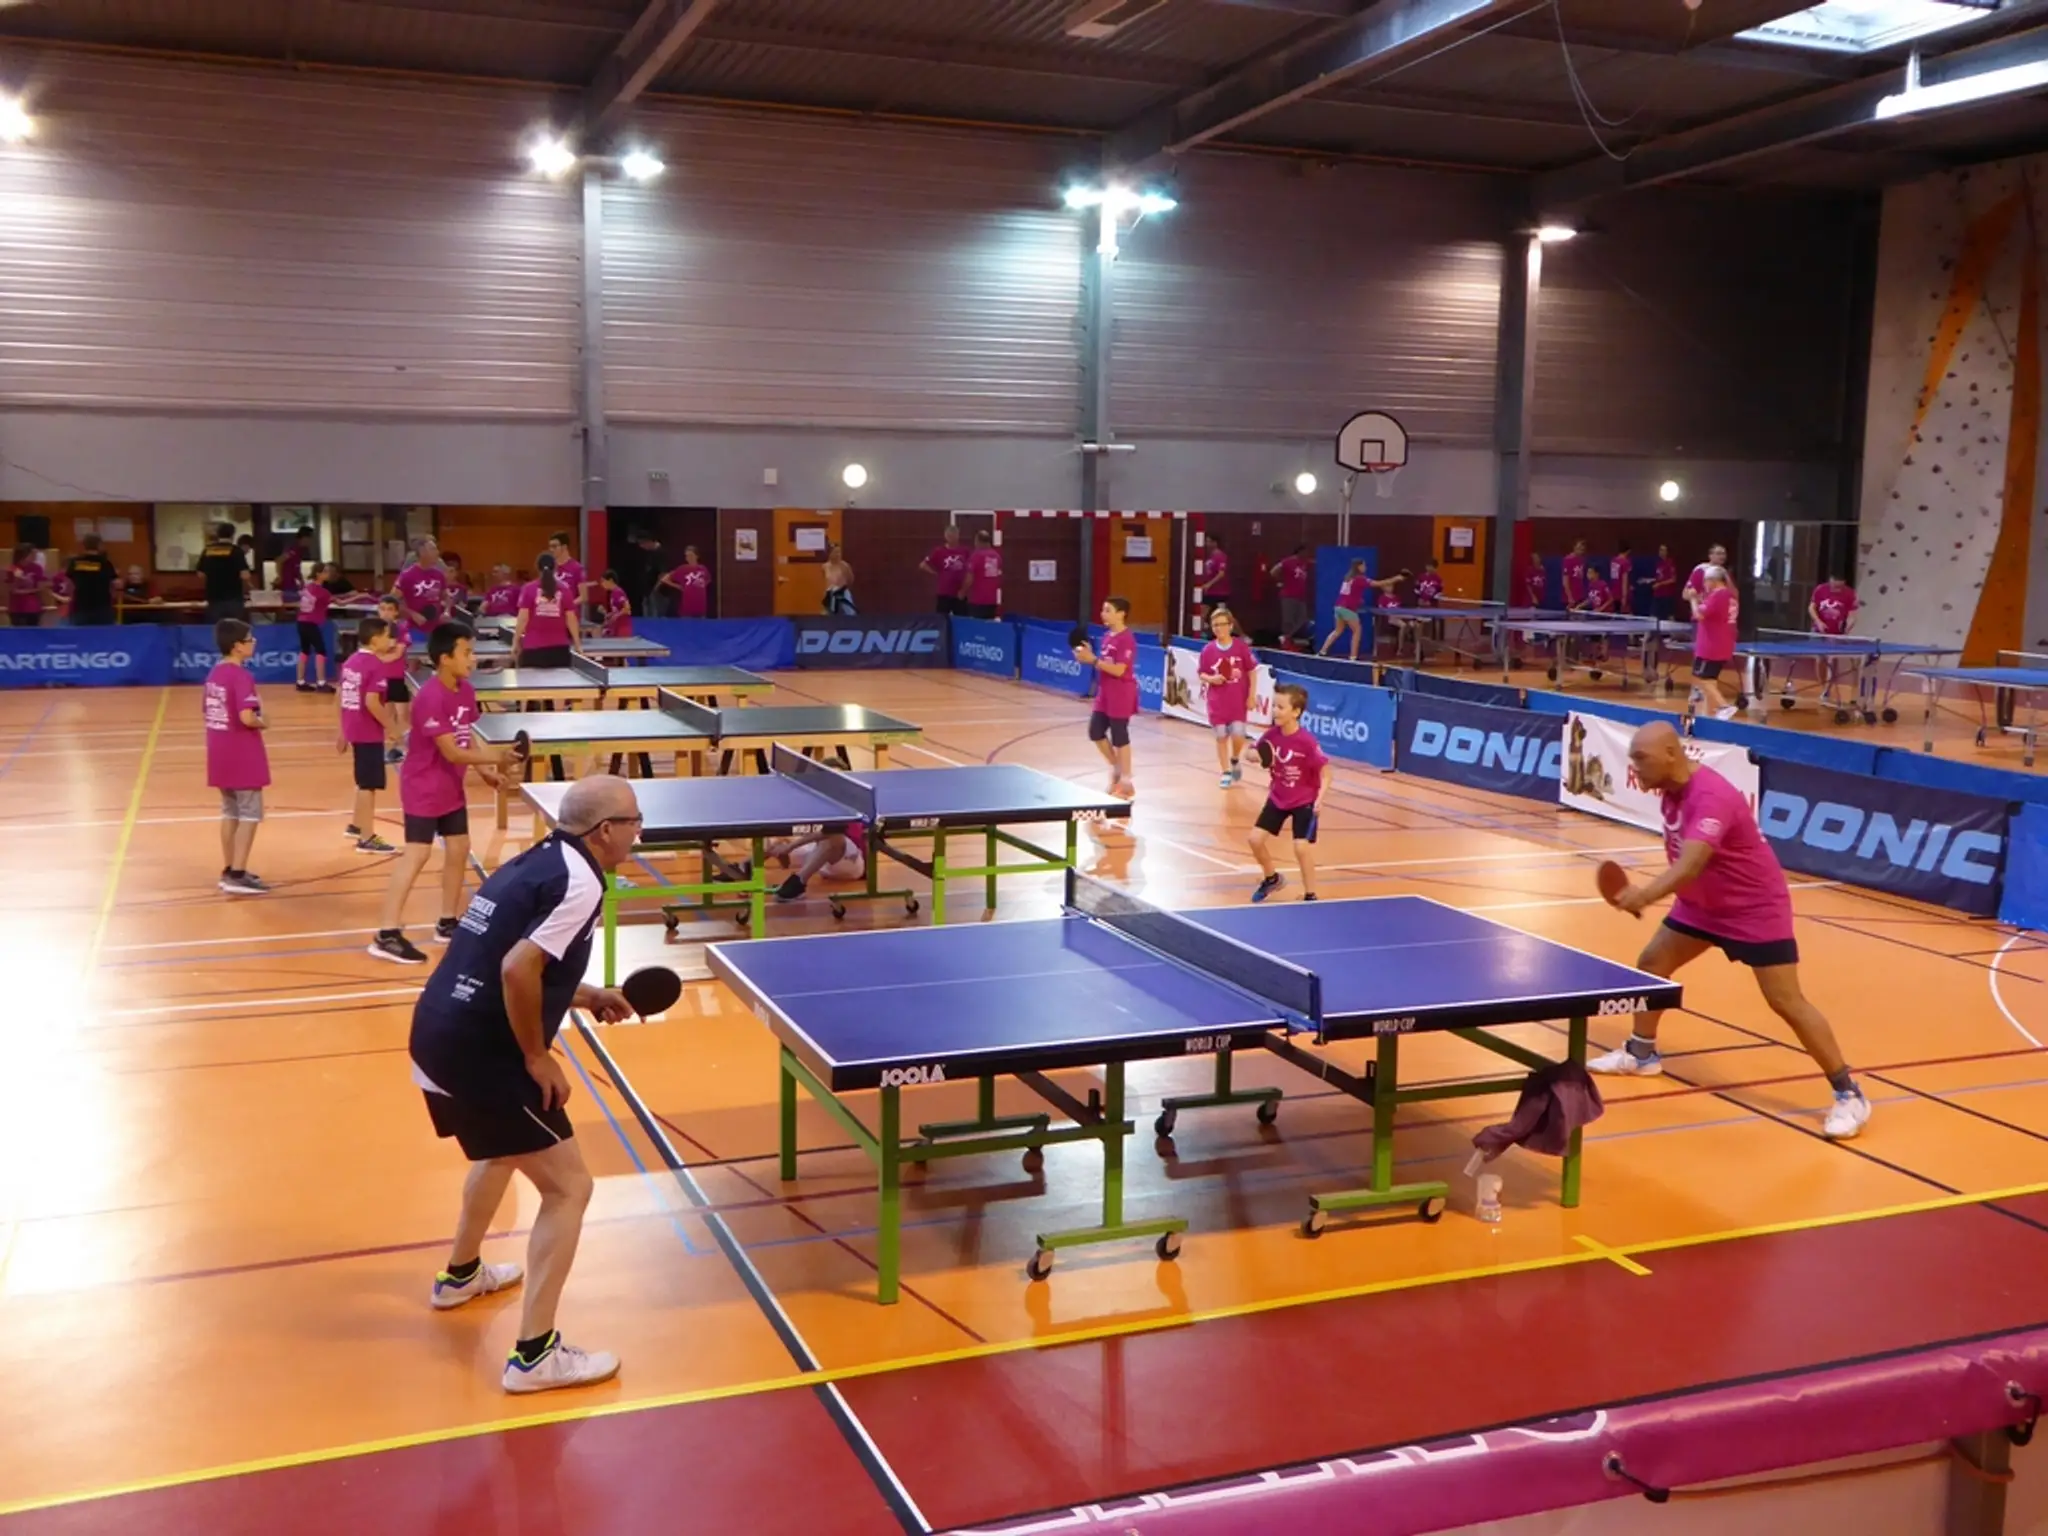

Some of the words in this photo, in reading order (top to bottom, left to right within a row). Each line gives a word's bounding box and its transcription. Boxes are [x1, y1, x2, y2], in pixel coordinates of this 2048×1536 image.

[796, 630, 940, 654] DONIC
[959, 641, 1004, 662] ARTENGO
[0, 651, 131, 670] ARTENGO
[1036, 653, 1081, 677] ARTENGO
[1300, 711, 1369, 743] RTENGO
[1071, 809, 1107, 821] JOOLA
[1759, 789, 2001, 885] DONIC
[1598, 996, 1648, 1016] JOOLA
[1186, 1035, 1213, 1051] WORLD
[1215, 1034, 1232, 1049] CUP
[880, 1063, 946, 1088] JOOLA
